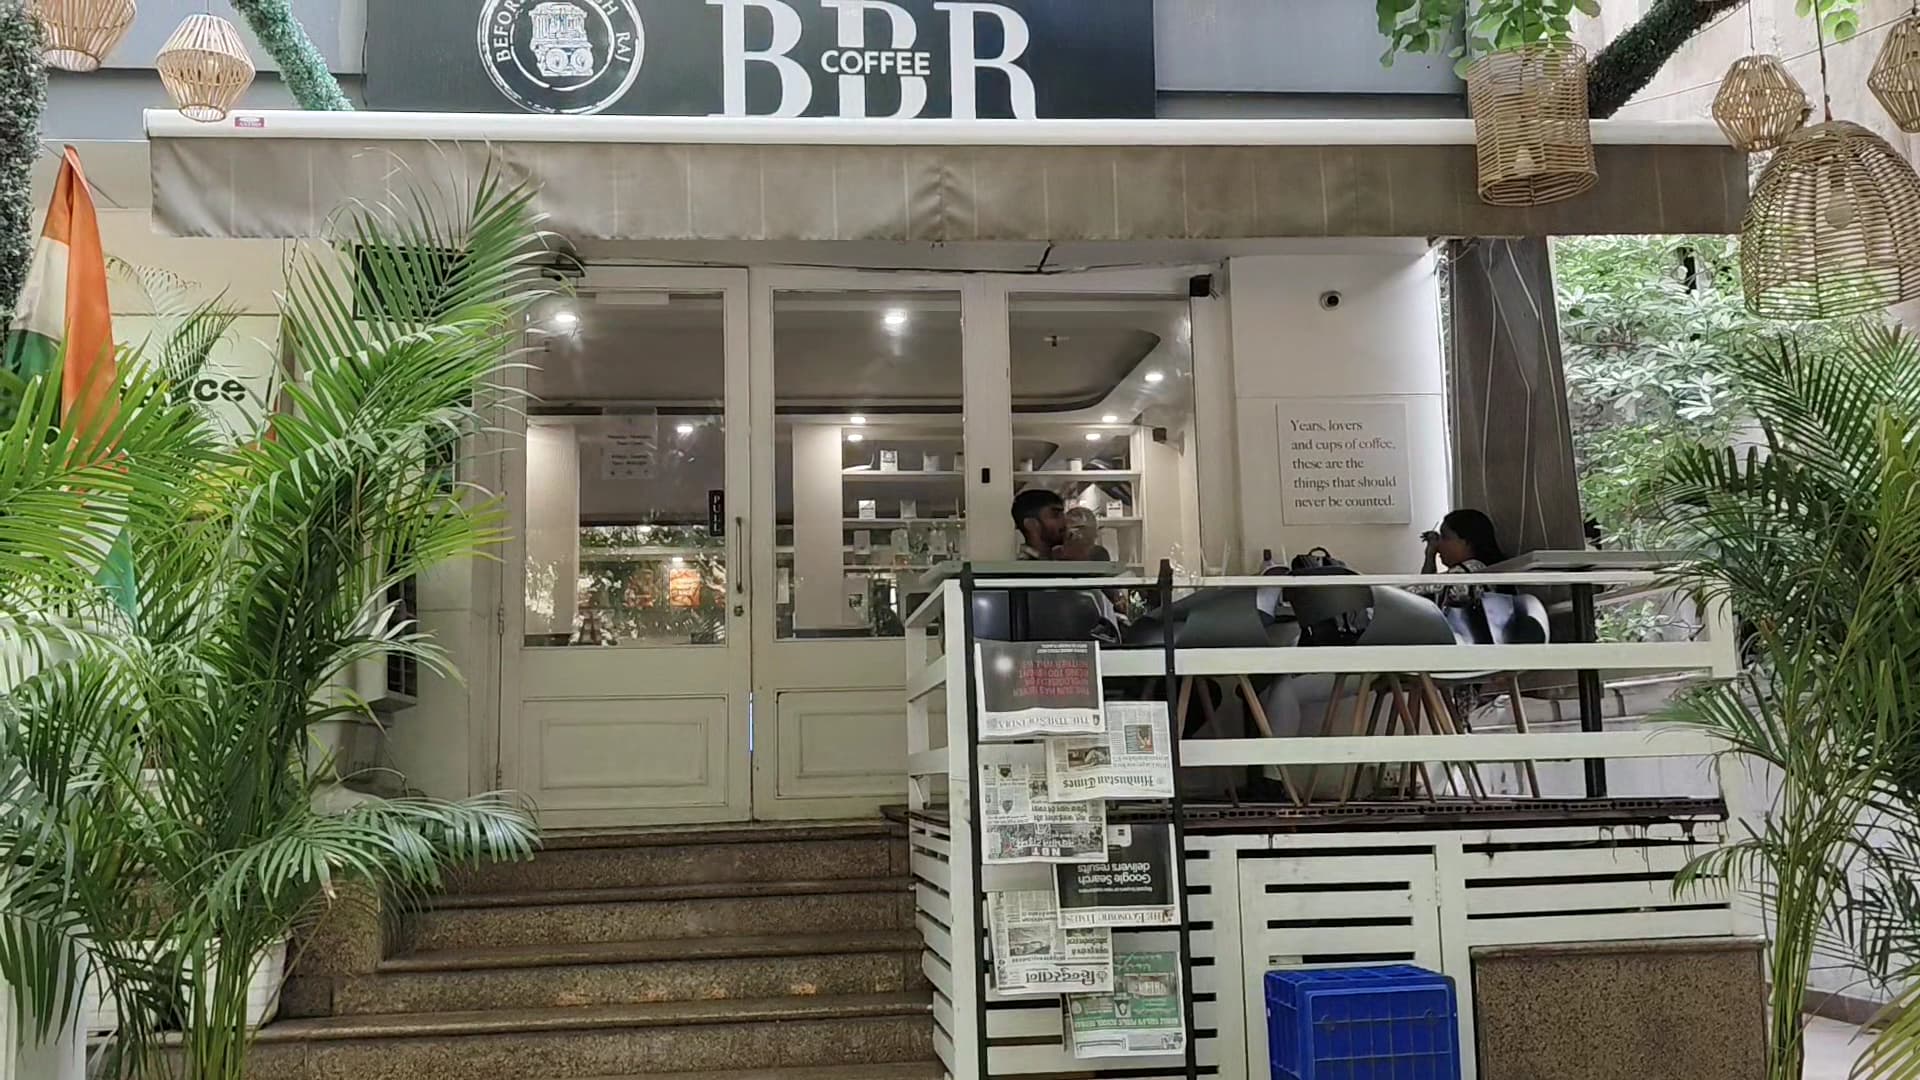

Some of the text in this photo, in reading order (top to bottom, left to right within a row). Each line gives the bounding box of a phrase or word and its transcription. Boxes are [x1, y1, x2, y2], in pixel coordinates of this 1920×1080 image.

[493, 0, 631, 62] BEFOR RAJ
[821, 49, 931, 75] COFFEE
[1328, 420, 1362, 431] lovers
[1291, 438, 1312, 450] and
[1316, 441, 1343, 453] cups
[1345, 438, 1357, 449] of
[1292, 458, 1364, 469] these are the
[1294, 476, 1397, 491] things that should
[1295, 495, 1395, 508] never be counted.
[1063, 777, 1096, 790] Times
[1077, 862, 1151, 874] delivers results
[1078, 871, 1151, 885] Google Search
